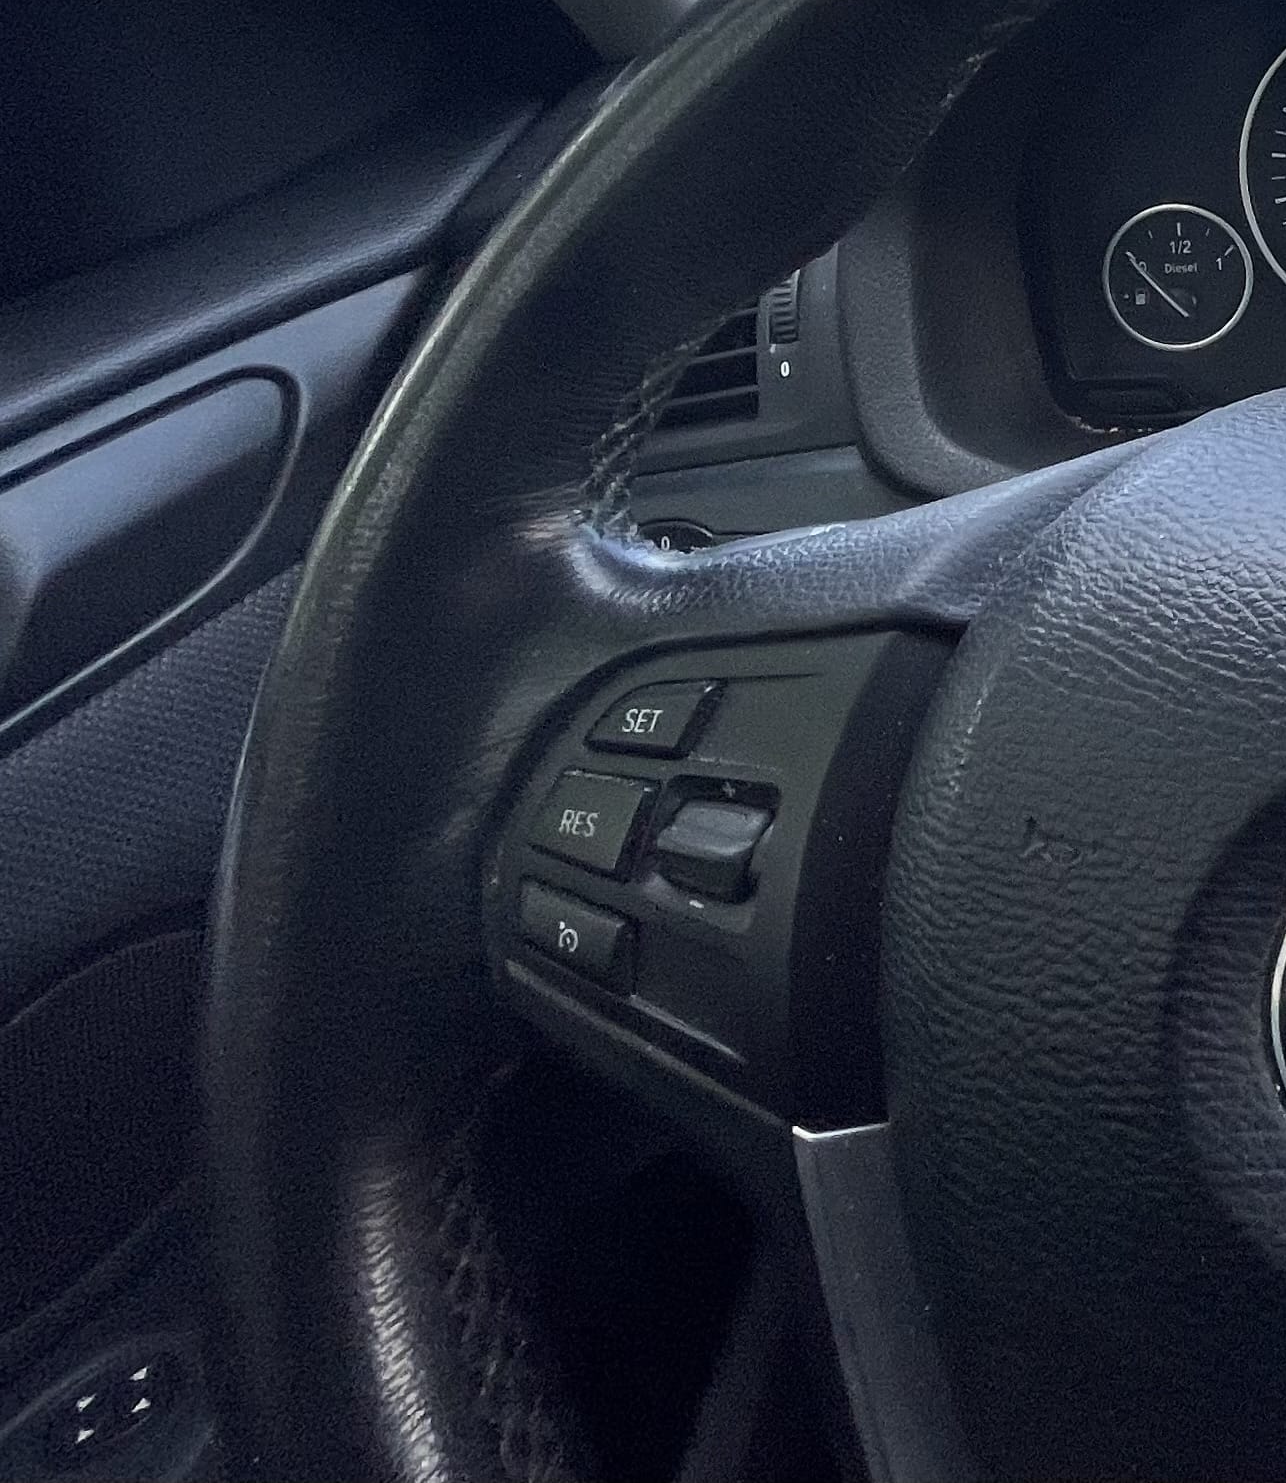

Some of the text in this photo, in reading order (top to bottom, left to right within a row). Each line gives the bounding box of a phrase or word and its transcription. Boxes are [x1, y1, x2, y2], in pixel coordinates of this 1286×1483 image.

[1169, 240, 1192, 254] 1/2
[1164, 263, 1198, 274] Diesel
[1215, 257, 1222, 270] 1
[622, 709, 663, 733] SET
[559, 810, 599, 838] RES
